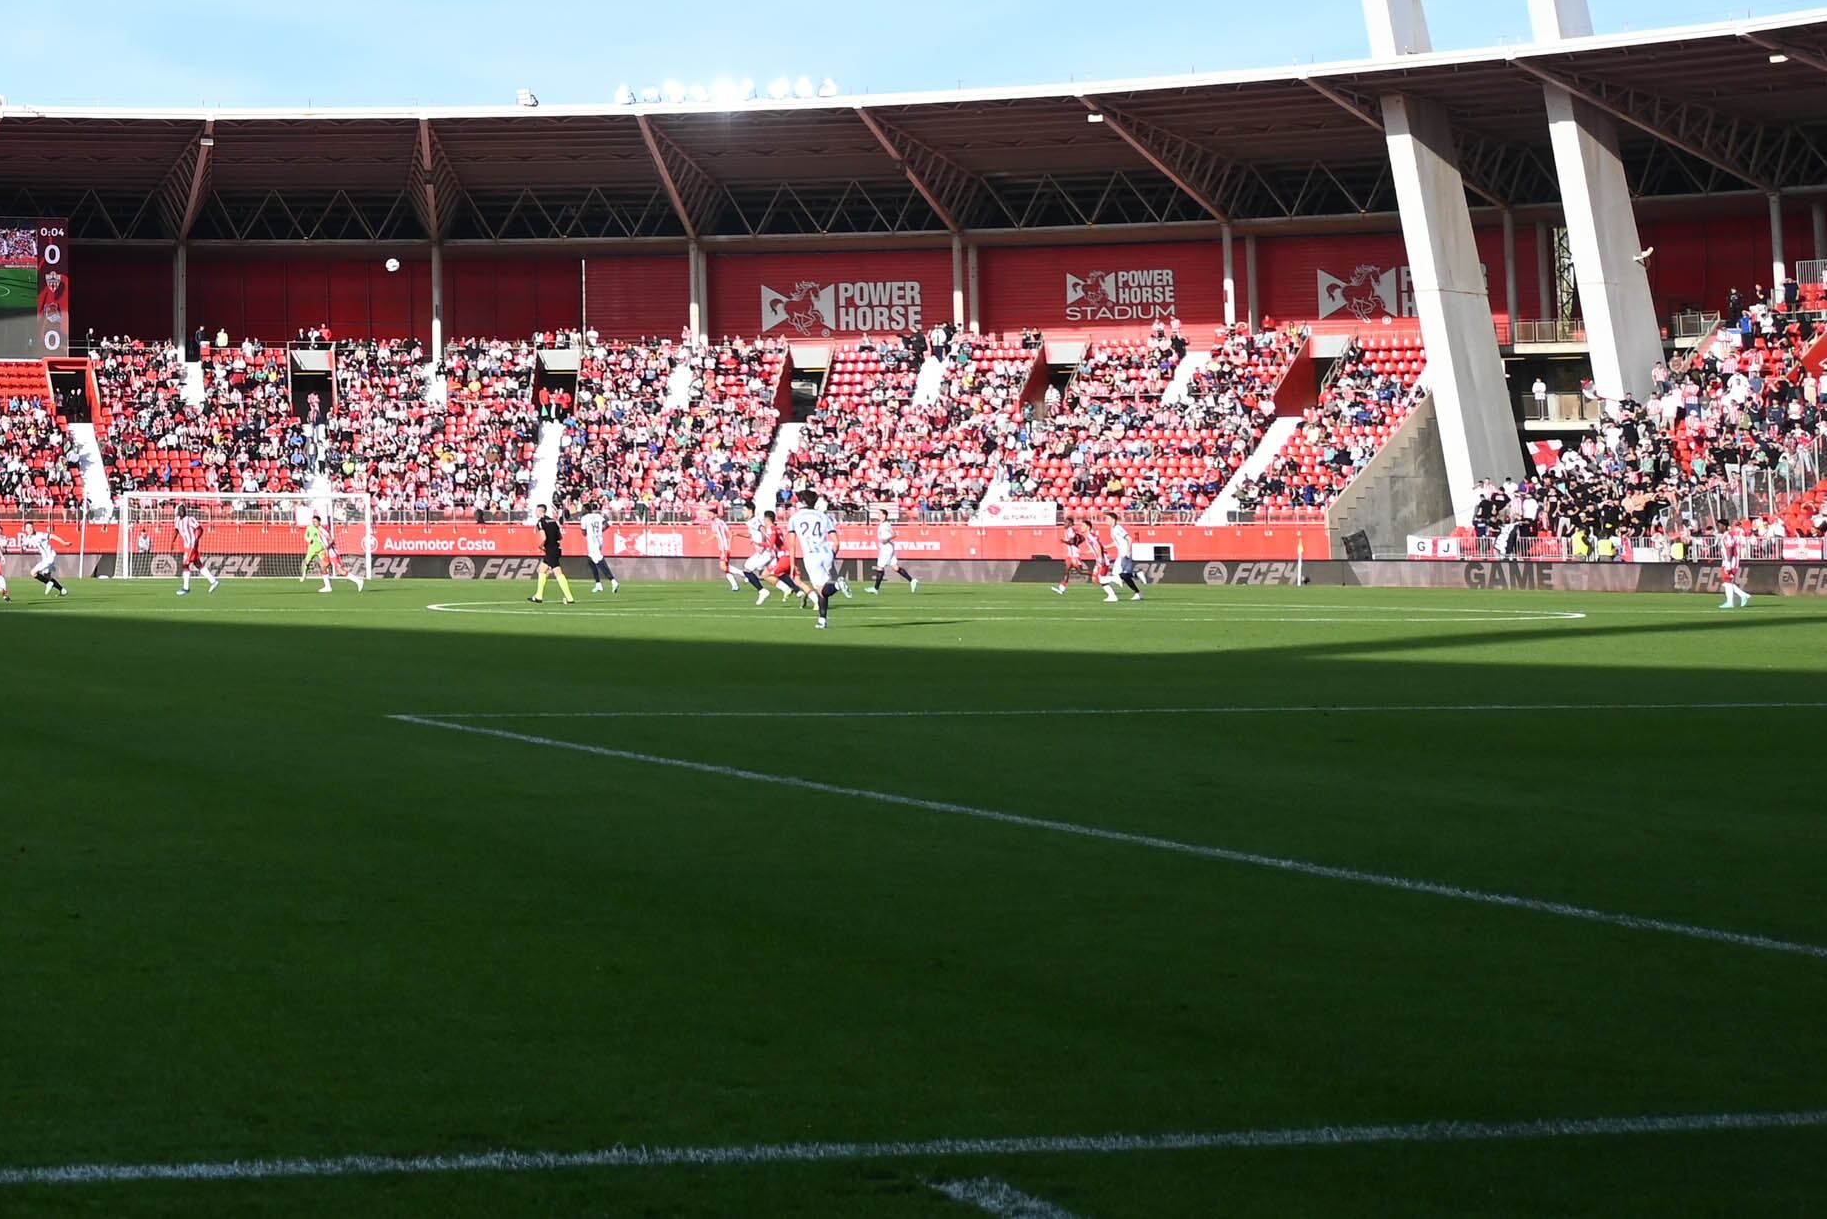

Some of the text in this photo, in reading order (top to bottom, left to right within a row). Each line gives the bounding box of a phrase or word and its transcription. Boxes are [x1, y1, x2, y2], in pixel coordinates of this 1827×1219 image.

[40, 228, 65, 237] 0:04
[44, 244, 61, 264] 0
[1118, 269, 1174, 287] POWER
[839, 282, 921, 306] POWER
[1118, 286, 1175, 304] HORSE
[840, 306, 921, 331] HORSE
[1065, 304, 1176, 321] STADIUM
[44, 330, 61, 351] 0
[590, 521, 600, 535] 19
[800, 521, 823, 538] 24
[383, 537, 496, 551] Automotor Costa
[1417, 541, 1451, 553] G J
[454, 562, 472, 571] EA
[480, 558, 542, 579] FC2
[1208, 566, 1224, 576] EA
[1231, 563, 1302, 585] FC24
[1464, 563, 1553, 590] GAME
[1781, 571, 1794, 583] EA
